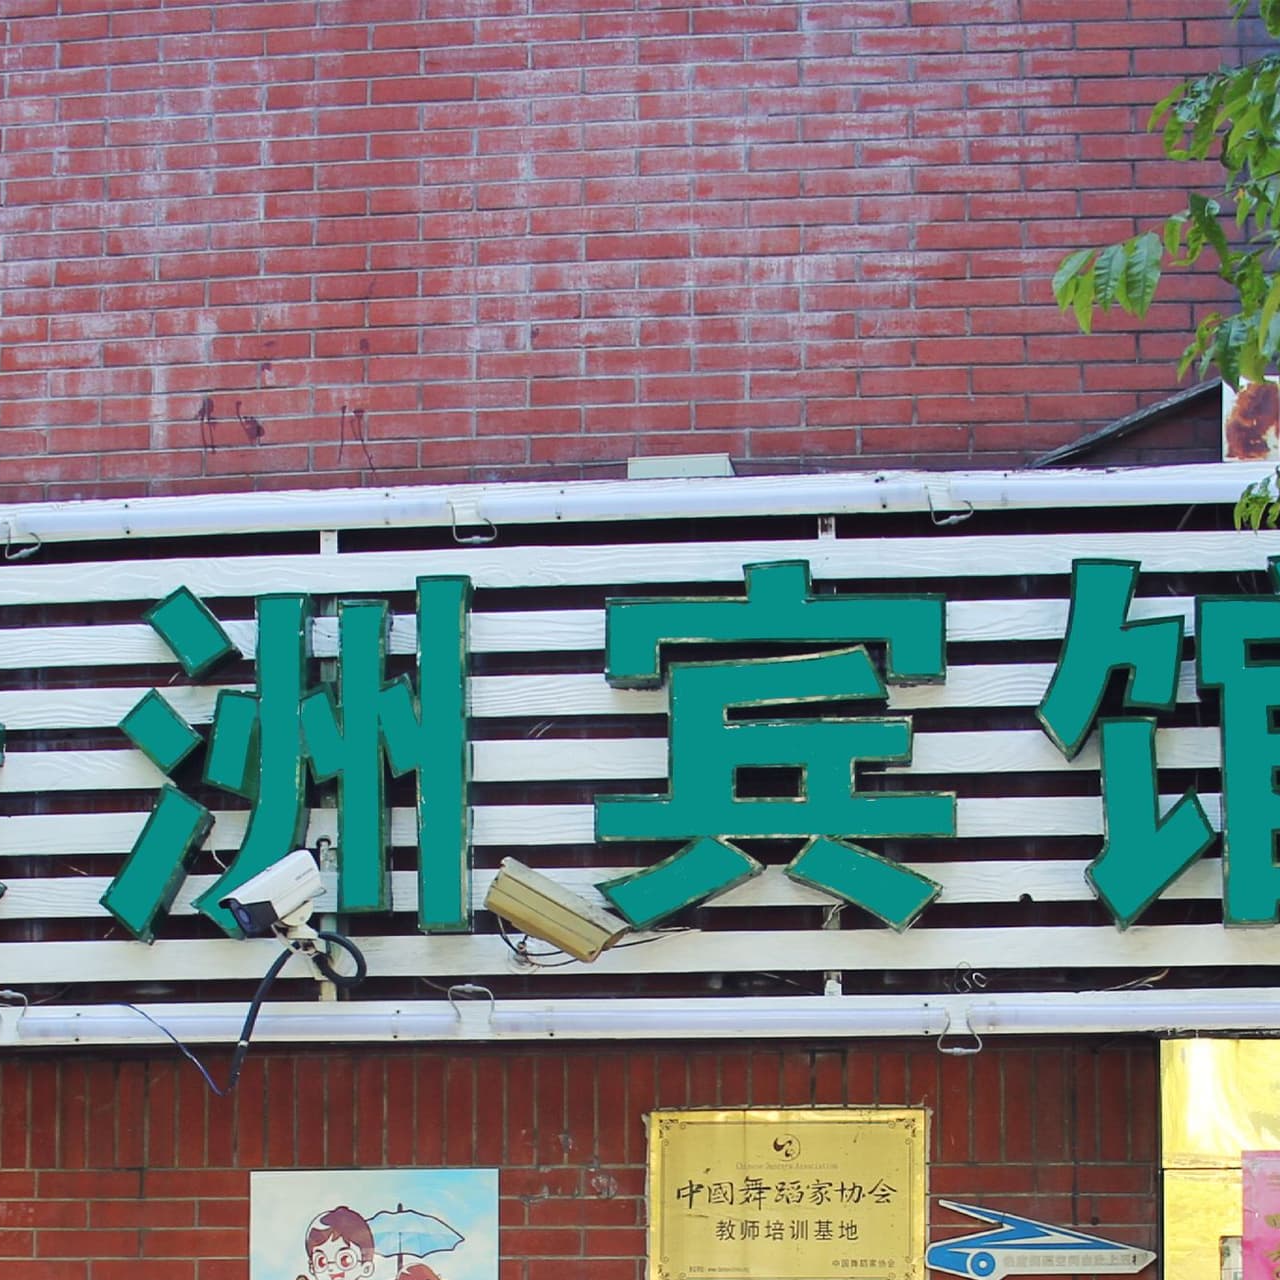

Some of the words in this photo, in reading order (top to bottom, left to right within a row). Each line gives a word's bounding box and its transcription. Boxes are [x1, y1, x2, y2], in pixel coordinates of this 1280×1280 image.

[715, 1219, 860, 1241] 教师培训基地
